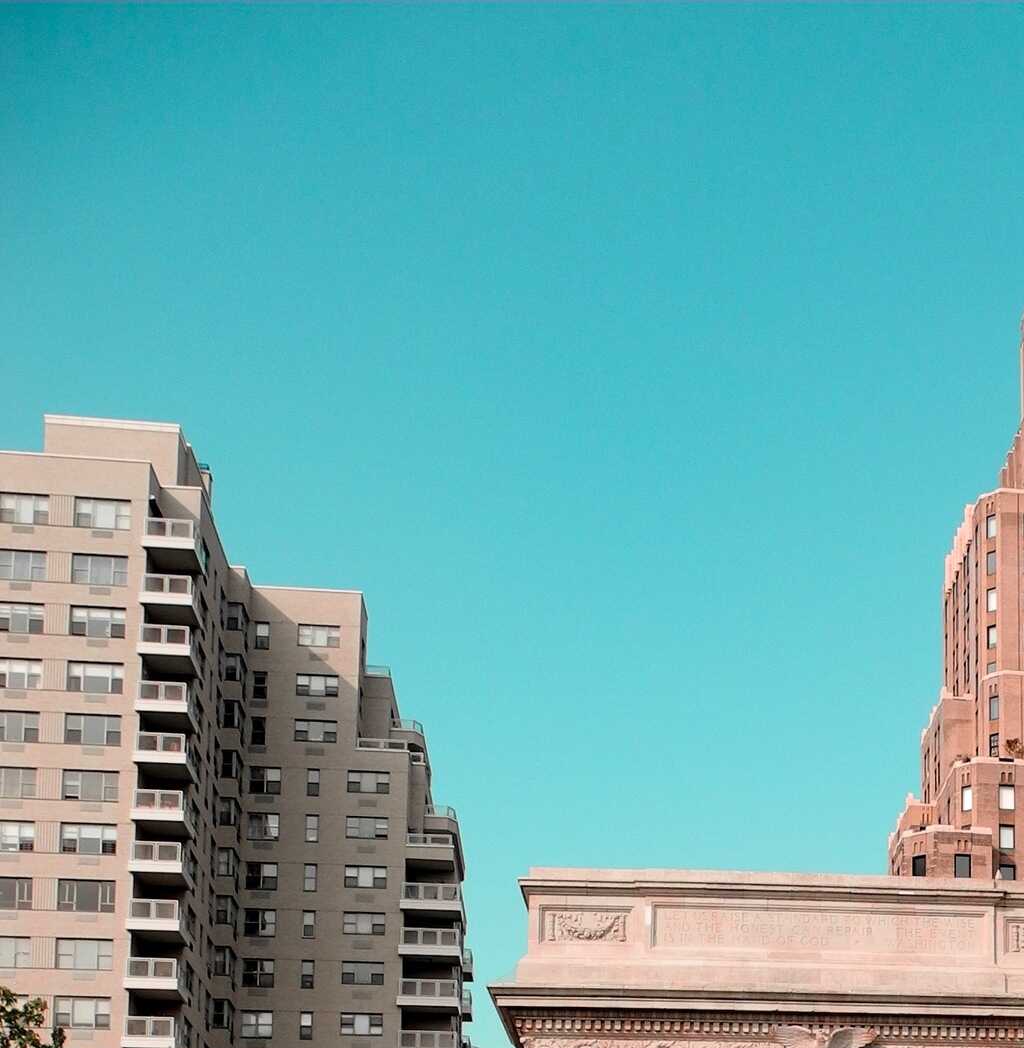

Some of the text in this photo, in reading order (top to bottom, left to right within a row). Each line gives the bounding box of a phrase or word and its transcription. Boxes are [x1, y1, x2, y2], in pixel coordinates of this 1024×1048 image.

[695, 922, 722, 933] THE
[730, 923, 784, 935] HONEST
[826, 926, 873, 937] REPAIR
[895, 927, 922, 938] THE
